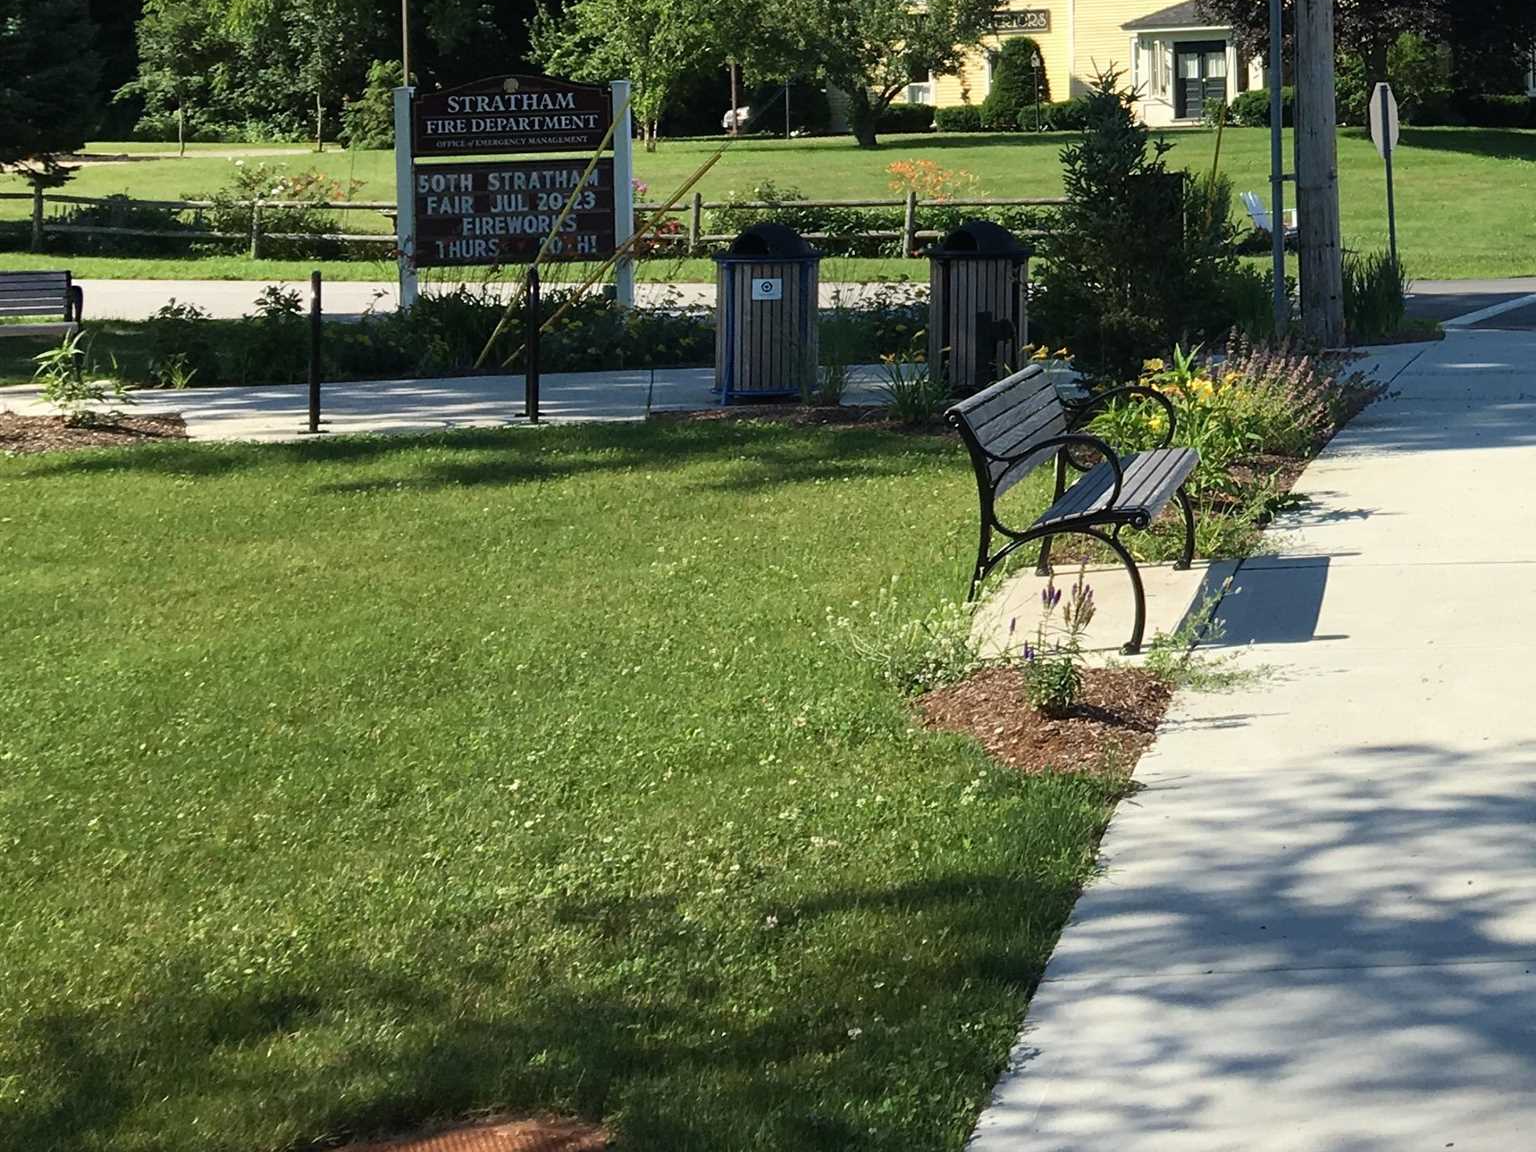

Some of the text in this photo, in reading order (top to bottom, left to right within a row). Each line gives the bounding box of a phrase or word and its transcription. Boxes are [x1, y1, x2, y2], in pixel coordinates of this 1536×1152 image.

[447, 92, 576, 113] STRATHAM
[426, 114, 599, 134] FIRE DEPARTMENT
[436, 139, 465, 148] OFFICE
[475, 137, 527, 147] EMERGENCY
[528, 135, 588, 145] MANAGEMENT
[418, 168, 599, 193] 50TH STRATHAM
[427, 195, 474, 215] FAIR
[491, 192, 529, 213] JUL
[435, 239, 499, 258] THURS
